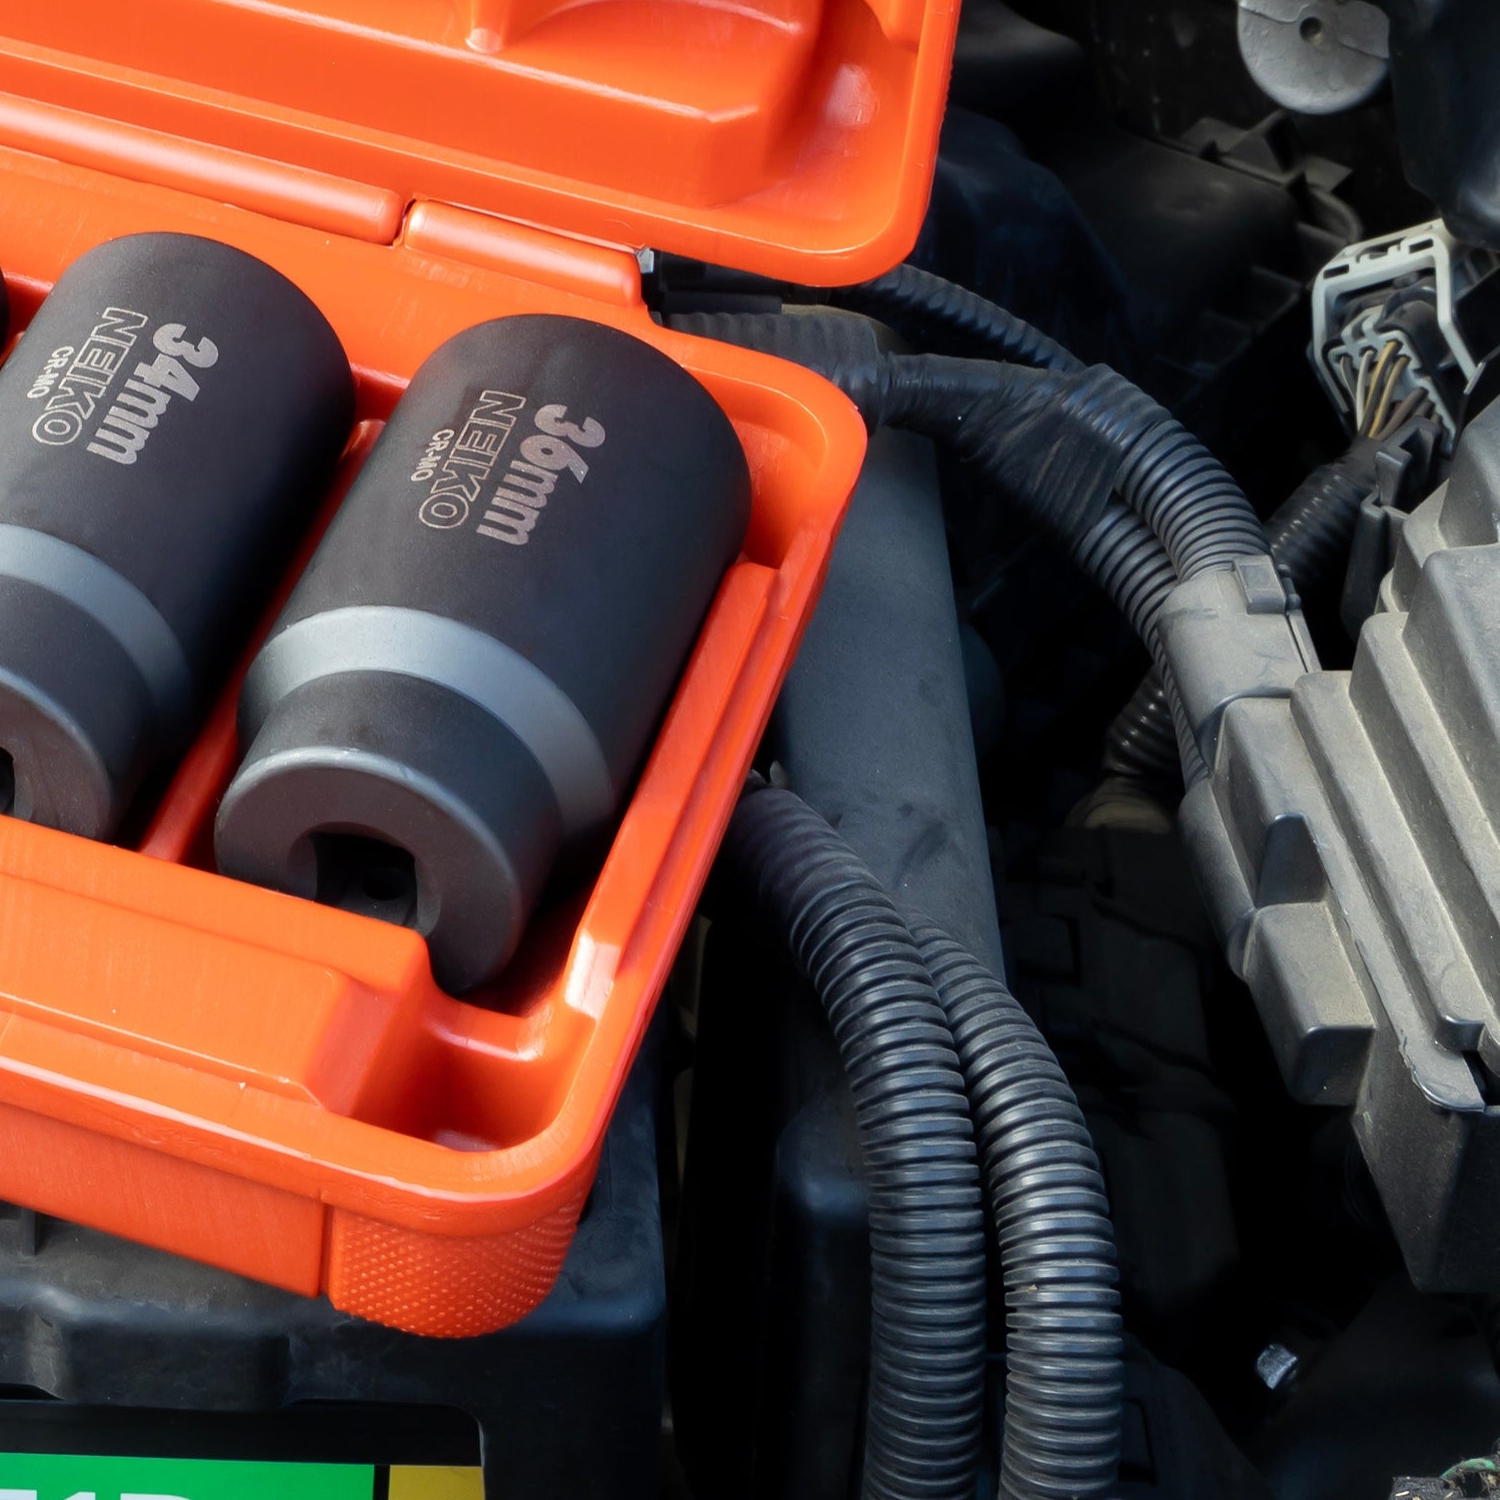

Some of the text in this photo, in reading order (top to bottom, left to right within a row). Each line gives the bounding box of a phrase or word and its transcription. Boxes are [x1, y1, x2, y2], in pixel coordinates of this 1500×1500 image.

[31, 306, 149, 446] NEIKO
[86, 322, 219, 465] 34mm
[418, 389, 527, 530] NEIKO
[476, 403, 606, 546] 36mm
